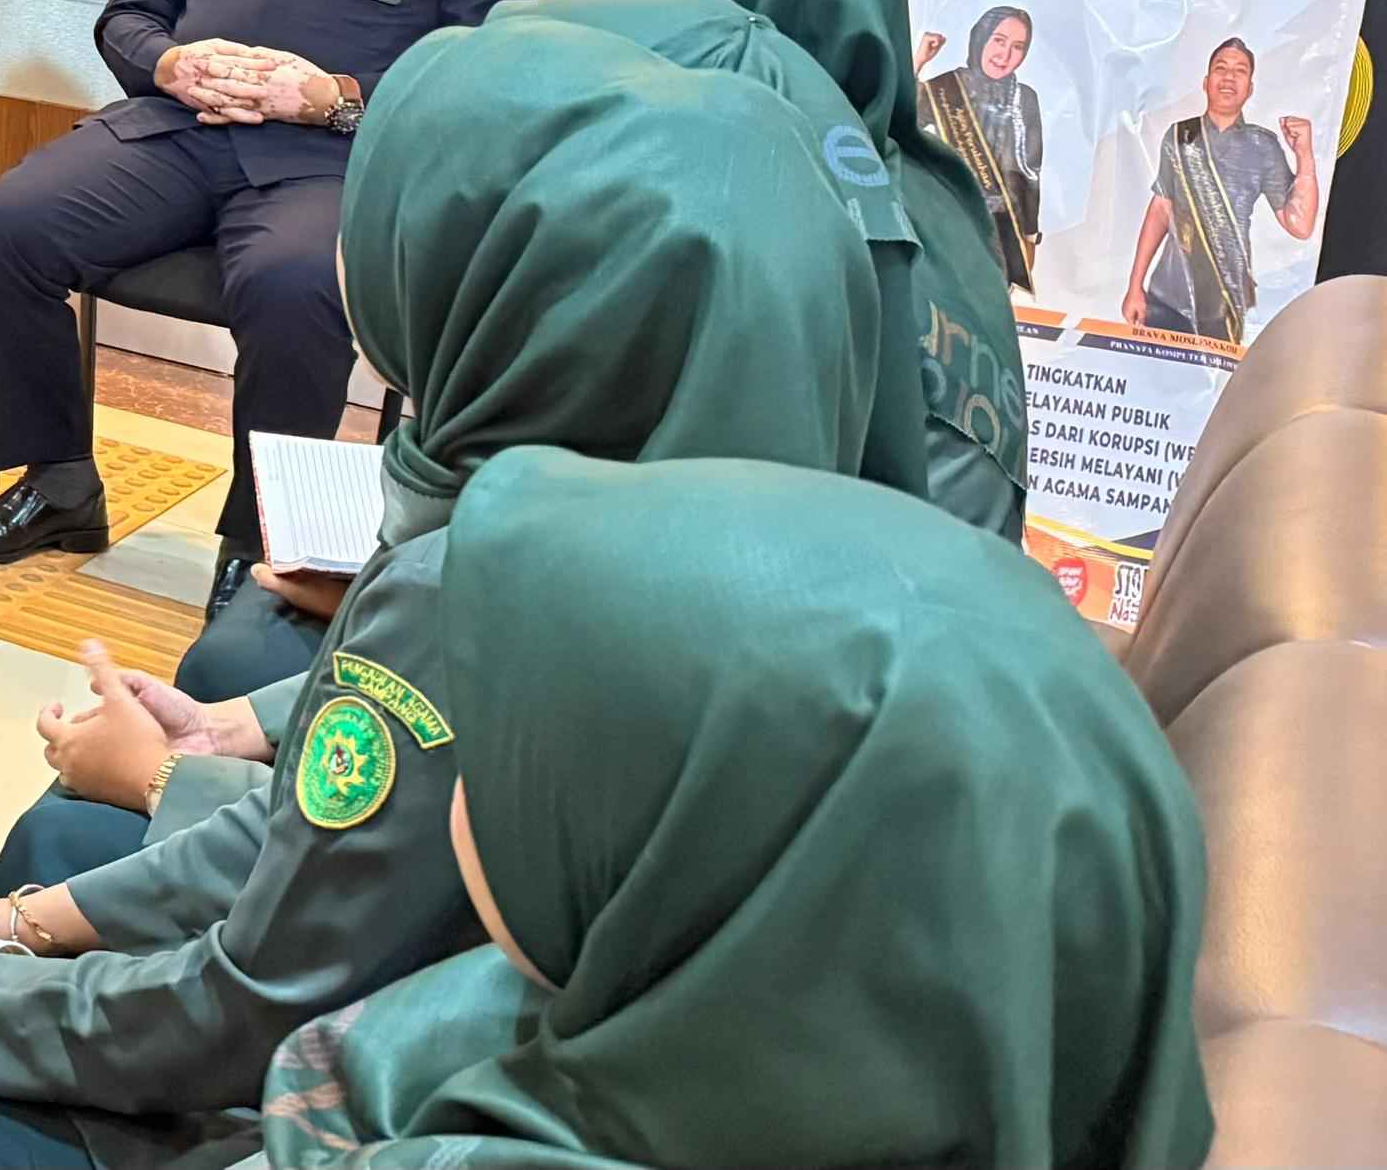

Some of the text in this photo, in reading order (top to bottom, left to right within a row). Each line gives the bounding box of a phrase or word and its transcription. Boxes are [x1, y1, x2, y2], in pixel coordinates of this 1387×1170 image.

[1028, 364, 1127, 395] TINGKATKAN
[1112, 405, 1171, 430] PUBLIK
[1045, 422, 1083, 443] DARI
[1089, 430, 1160, 457] KORUPSI
[1081, 455, 1163, 485] MELAYANI
[1043, 478, 1100, 502] AGAMA
